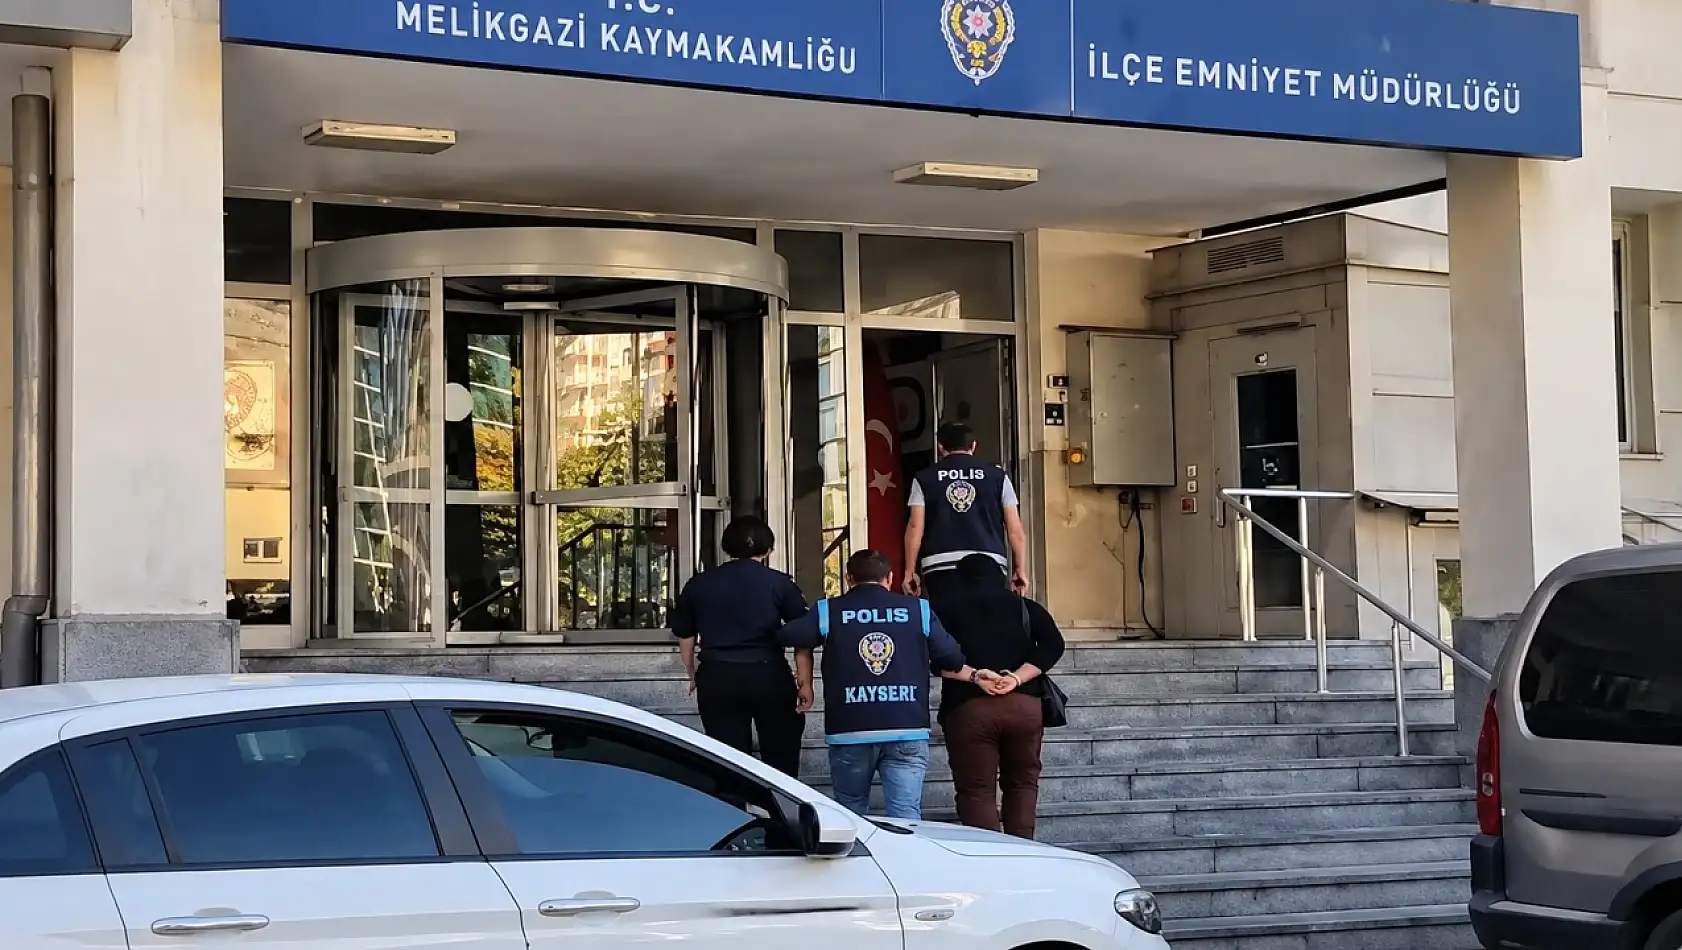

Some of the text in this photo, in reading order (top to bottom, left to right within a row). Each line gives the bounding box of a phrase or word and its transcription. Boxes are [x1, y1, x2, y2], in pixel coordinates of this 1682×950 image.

[396, 0, 856, 75] MELİKGAZİ KAYMAKAMLİĞU
[1089, 43, 1520, 114] İLÇE EMNİYET MÜDÜRLÜĞÜ
